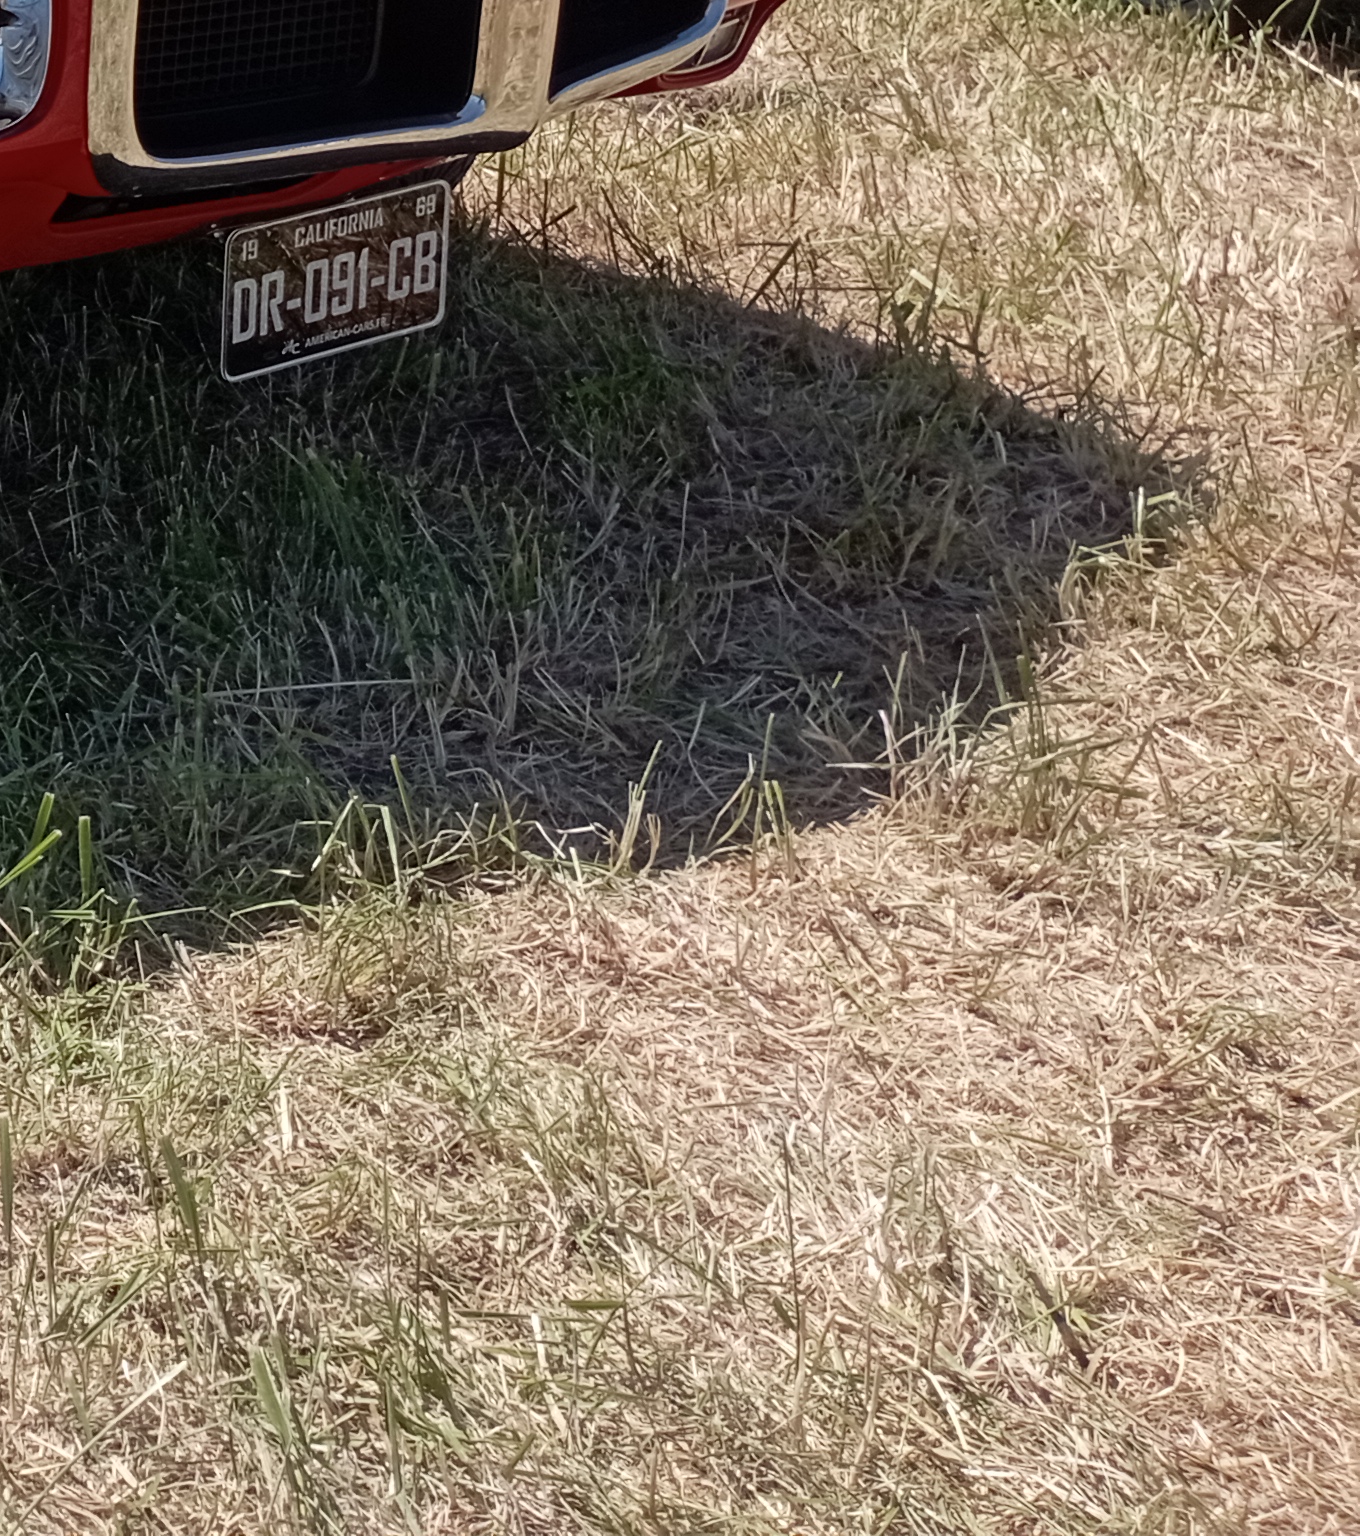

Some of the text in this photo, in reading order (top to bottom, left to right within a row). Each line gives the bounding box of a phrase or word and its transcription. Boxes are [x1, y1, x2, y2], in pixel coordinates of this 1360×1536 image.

[415, 193, 437, 218] 69
[294, 207, 385, 249] CALIFORNIA
[241, 238, 259, 262] 19
[231, 230, 439, 345] DR-091-CB
